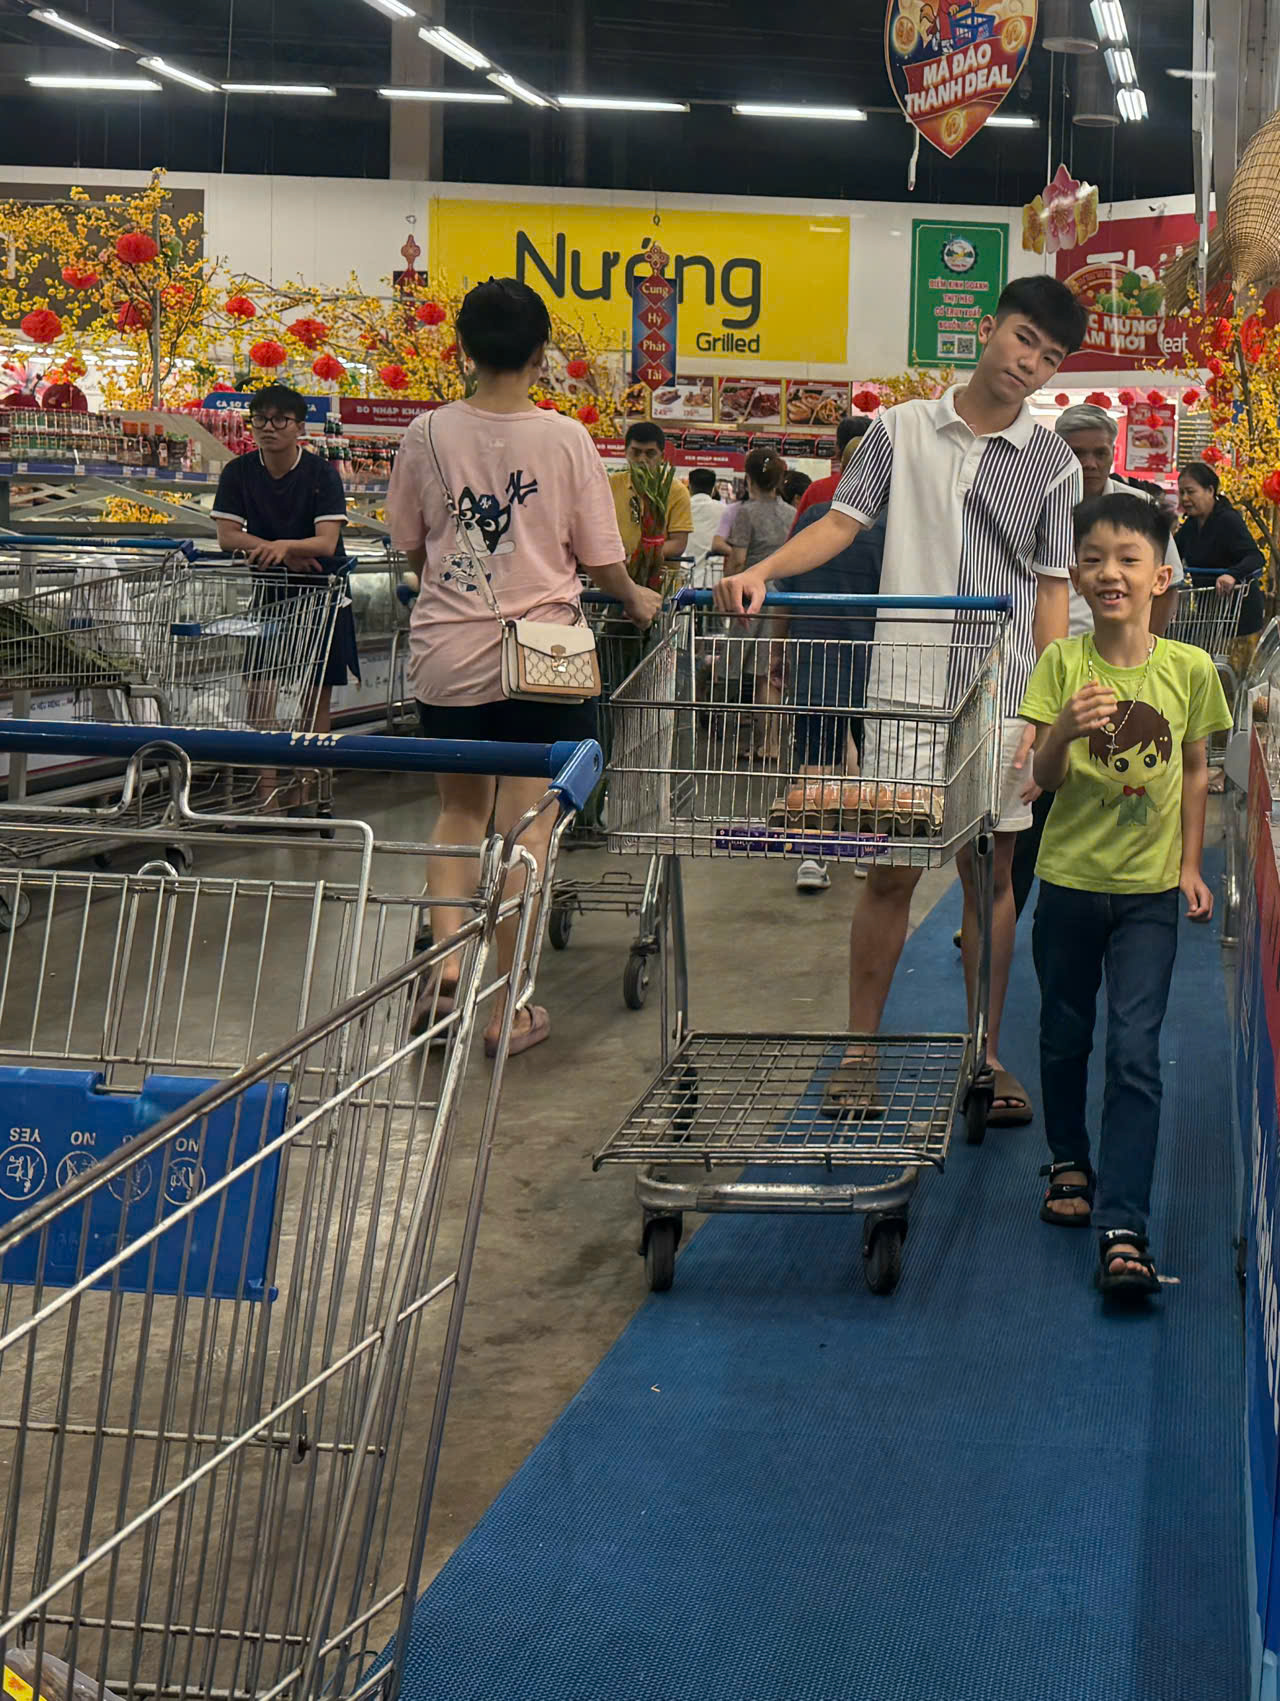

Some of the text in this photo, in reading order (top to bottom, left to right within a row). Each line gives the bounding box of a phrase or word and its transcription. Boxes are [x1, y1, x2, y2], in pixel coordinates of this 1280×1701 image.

[964, 63, 1012, 96] DEAL
[641, 282, 669, 298] Cung
[642, 339, 667, 353] Phát
[696, 332, 761, 354] Grilled
[9, 1127, 41, 1144] YES
[70, 1130, 97, 1146] NO
[174, 1137, 200, 1153] NO
